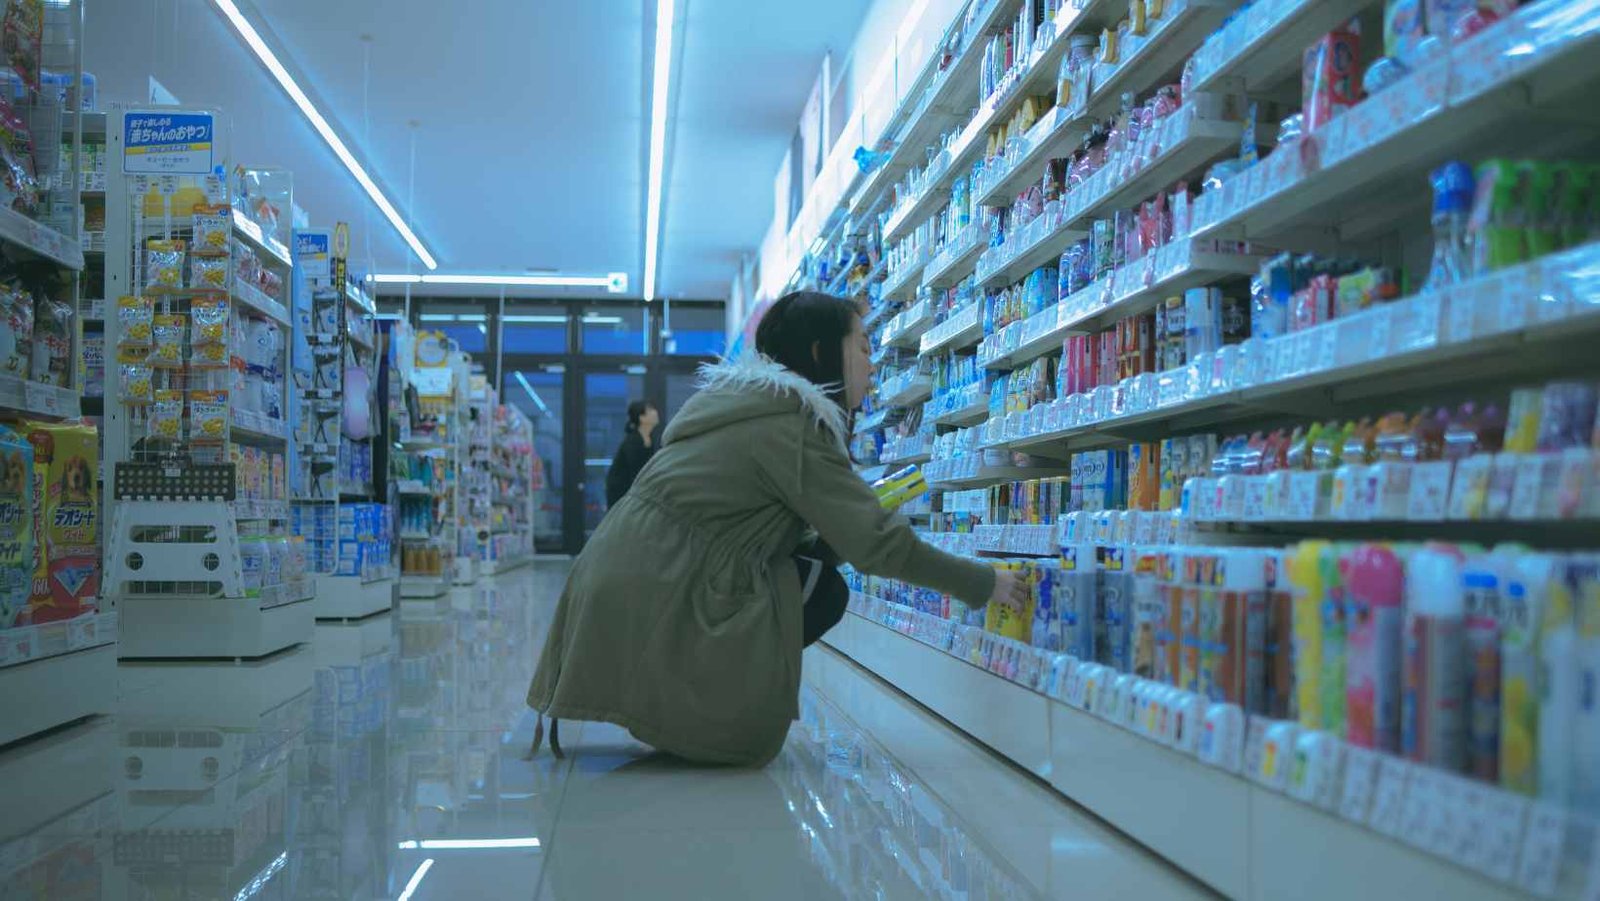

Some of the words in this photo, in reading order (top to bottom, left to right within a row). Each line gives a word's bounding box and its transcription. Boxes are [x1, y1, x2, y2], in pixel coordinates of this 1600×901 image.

[54, 508, 96, 526] デオシート
